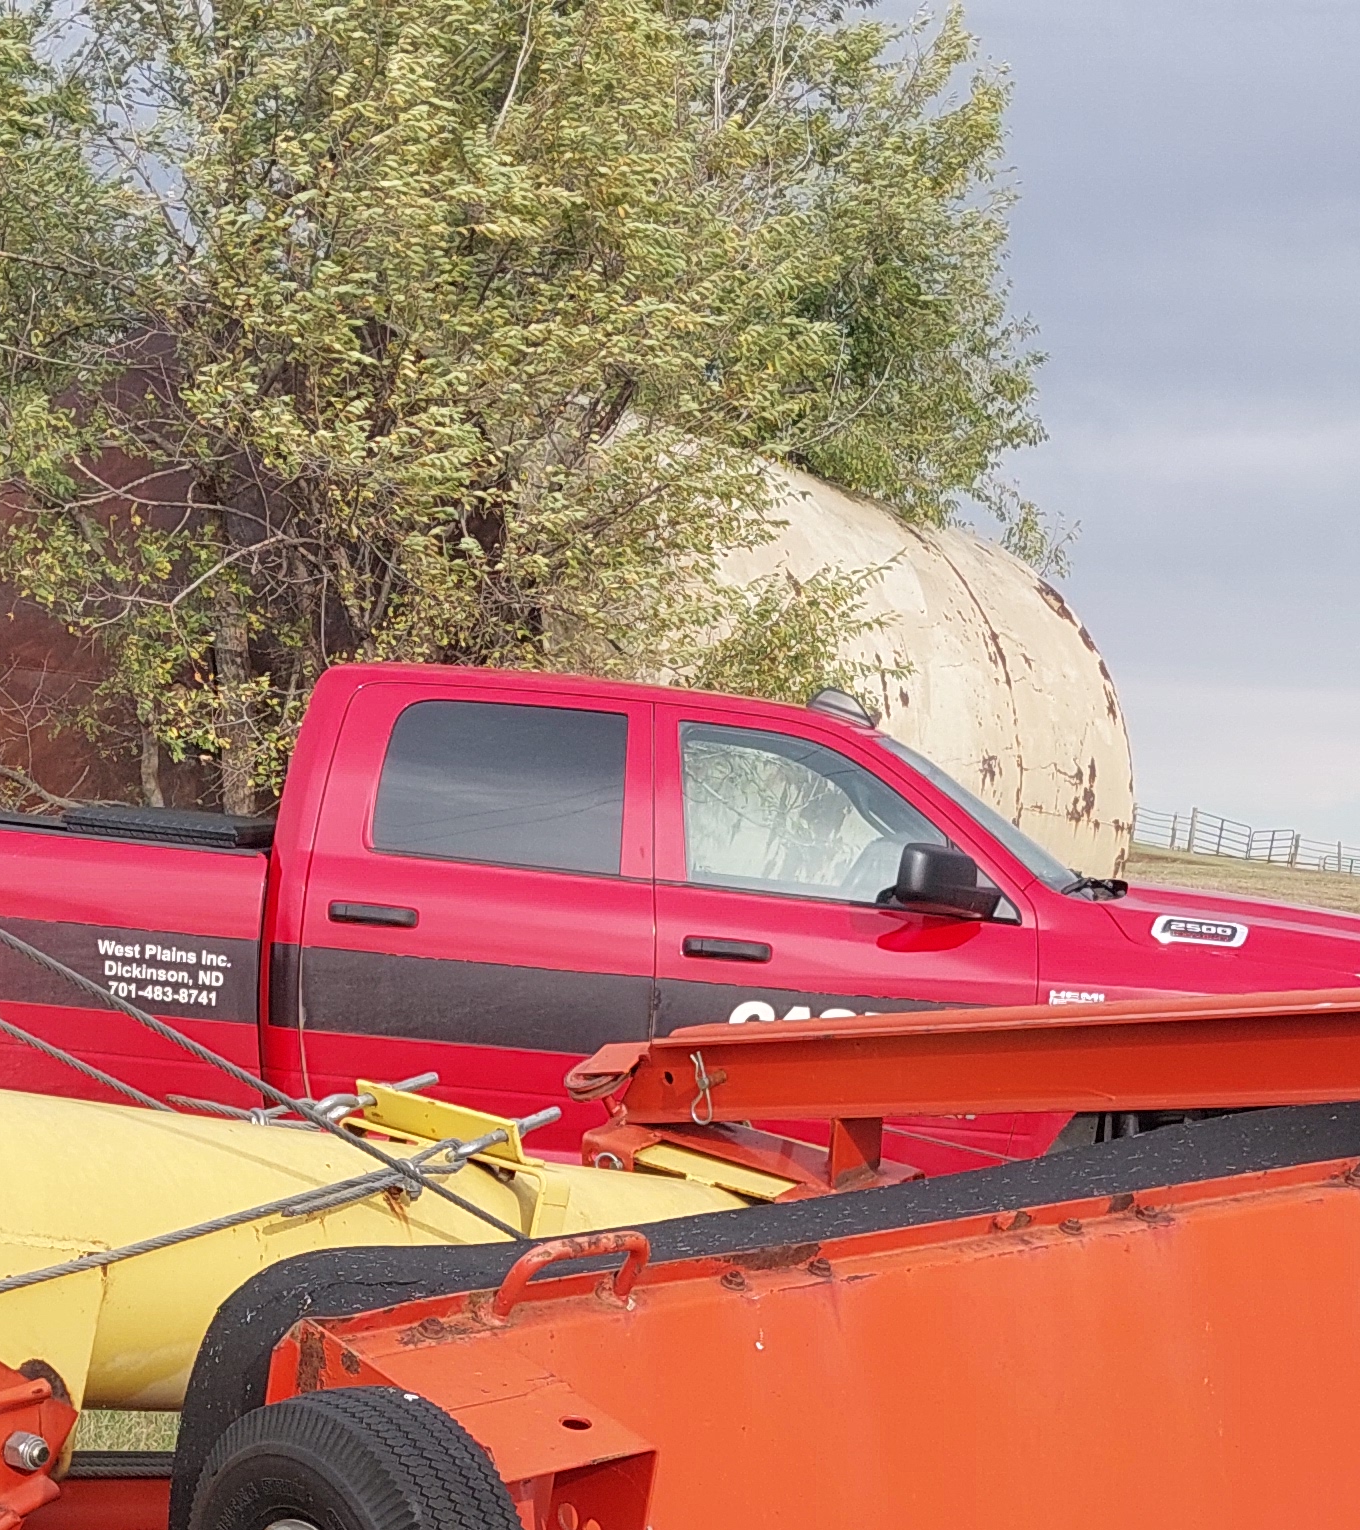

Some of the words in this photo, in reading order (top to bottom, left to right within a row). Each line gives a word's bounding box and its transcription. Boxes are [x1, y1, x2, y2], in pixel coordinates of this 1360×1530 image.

[1170, 921, 1233, 936] 2500
[97, 938, 141, 959] West
[144, 943, 197, 964] Plains
[201, 949, 232, 968] Inc.
[104, 960, 194, 986] Dickinson,
[198, 970, 224, 987] ND
[108, 980, 217, 1007] 701-483-8741
[1049, 989, 1105, 1004] HEMI
